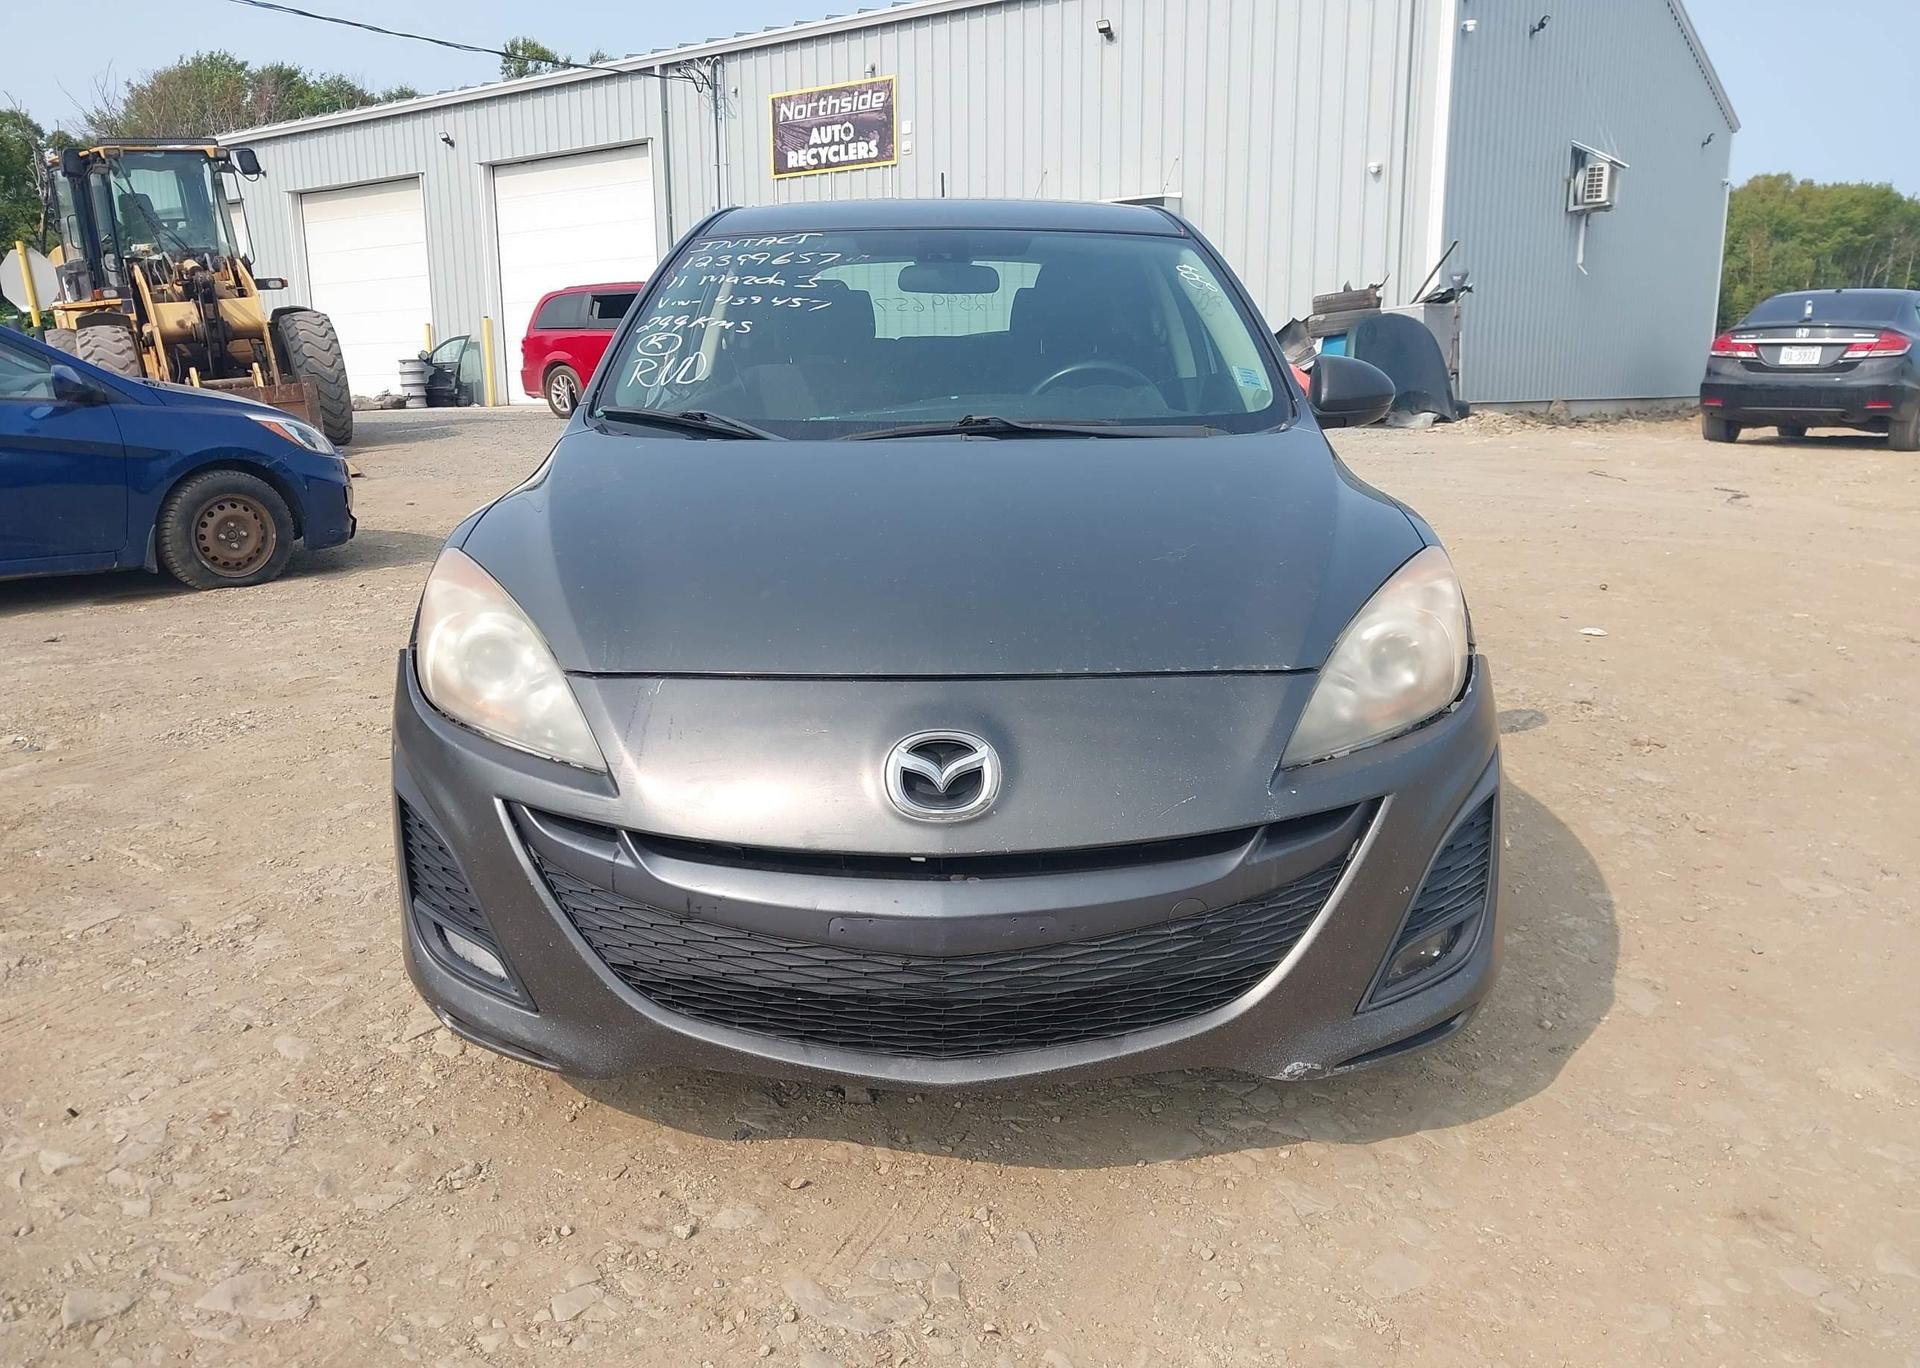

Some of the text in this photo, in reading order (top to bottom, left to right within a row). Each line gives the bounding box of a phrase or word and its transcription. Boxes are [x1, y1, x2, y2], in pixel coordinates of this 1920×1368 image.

[780, 89, 885, 121] Northside
[809, 121, 854, 145] AUTO
[787, 140, 878, 168] RECYCLERS
[691, 233, 823, 252] INTACT
[682, 252, 841, 269] 12399657
